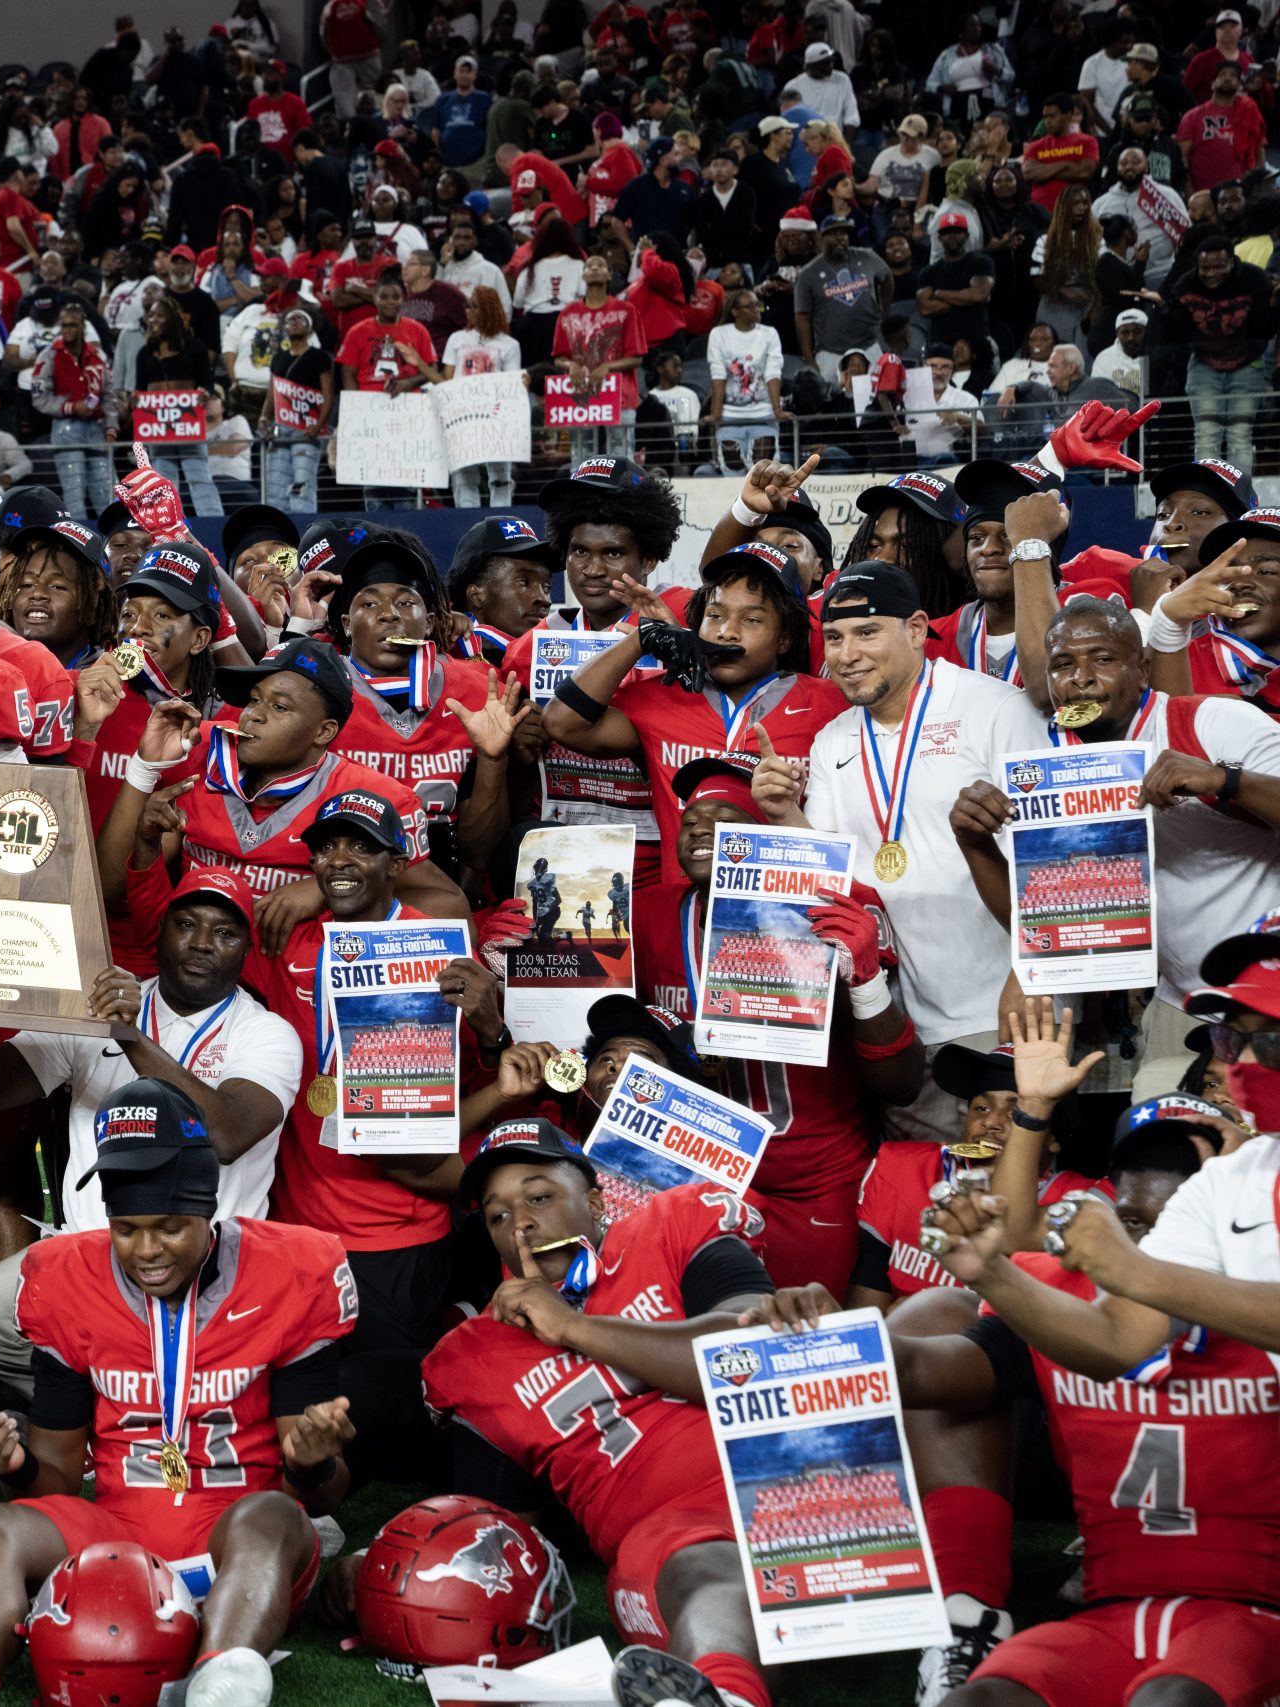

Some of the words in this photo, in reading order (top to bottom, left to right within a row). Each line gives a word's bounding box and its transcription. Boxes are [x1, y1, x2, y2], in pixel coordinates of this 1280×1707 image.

[293, 400, 309, 412] UP
[550, 405, 613, 423] SHORE
[157, 409, 181, 422] UP
[280, 410, 299, 424] ON
[139, 424, 166, 436] ON
[1199, 459, 1243, 478] TEXAS
[905, 473, 946, 492] TEXAS
[160, 550, 201, 573] TEXAS
[748, 542, 788, 564] TEXAS
[154, 559, 196, 582] STRONG
[541, 649, 570, 658] STATE
[923, 723, 942, 732] NORTH
[943, 720, 961, 729] SHORE
[919, 747, 957, 758] FOOTBALL
[410, 749, 473, 778] SHORE
[1010, 772, 1044, 783] STATE
[1051, 769, 1079, 784] TEXAS
[1080, 765, 1123, 780] FOOTBALL
[337, 801, 383, 823] STRONG
[341, 794, 386, 813] TEXAS
[2, 844, 32, 856] STATE
[34, 832, 60, 867] LEAGUE
[721, 842, 753, 854] STATE
[760, 847, 784, 861] TEXAS
[784, 850, 827, 865] FOOTBALL
[716, 866, 762, 891] STATE
[2, 938, 38, 948] CHAMPION
[43, 929, 62, 955] LEAGUE
[333, 942, 365, 952] STATE
[374, 941, 402, 955] TEXAS
[403, 939, 447, 952] FOOTBALL
[16, 960, 45, 968] AAAAAA
[516, 955, 534, 965] 100
[547, 954, 581, 965] TEXAS.
[331, 964, 385, 989] STATE
[516, 967, 543, 978] 100%
[544, 967, 581, 978] TEXAN.
[627, 1077, 664, 1100] STATE
[108, 1107, 157, 1121] TEXAS
[669, 1099, 699, 1124] TEXAS
[696, 1112, 742, 1143] FOOTBALL
[106, 1121, 156, 1134] STRONG
[489, 1124, 539, 1137] TEXAS
[608, 1098, 667, 1142] STATE
[663, 1125, 752, 1183] CHAMPS!
[712, 1358, 760, 1375] STATE
[770, 1352, 807, 1373] TEXAS
[806, 1343, 862, 1368] FOOTBALL
[716, 1386, 790, 1427] STATE
[791, 1371, 891, 1415] CHAMPS!
[1052, 1370, 1158, 1415] NORTH
[1168, 1377, 1280, 1416] SHORE
[1110, 1422, 1198, 1535] 4
